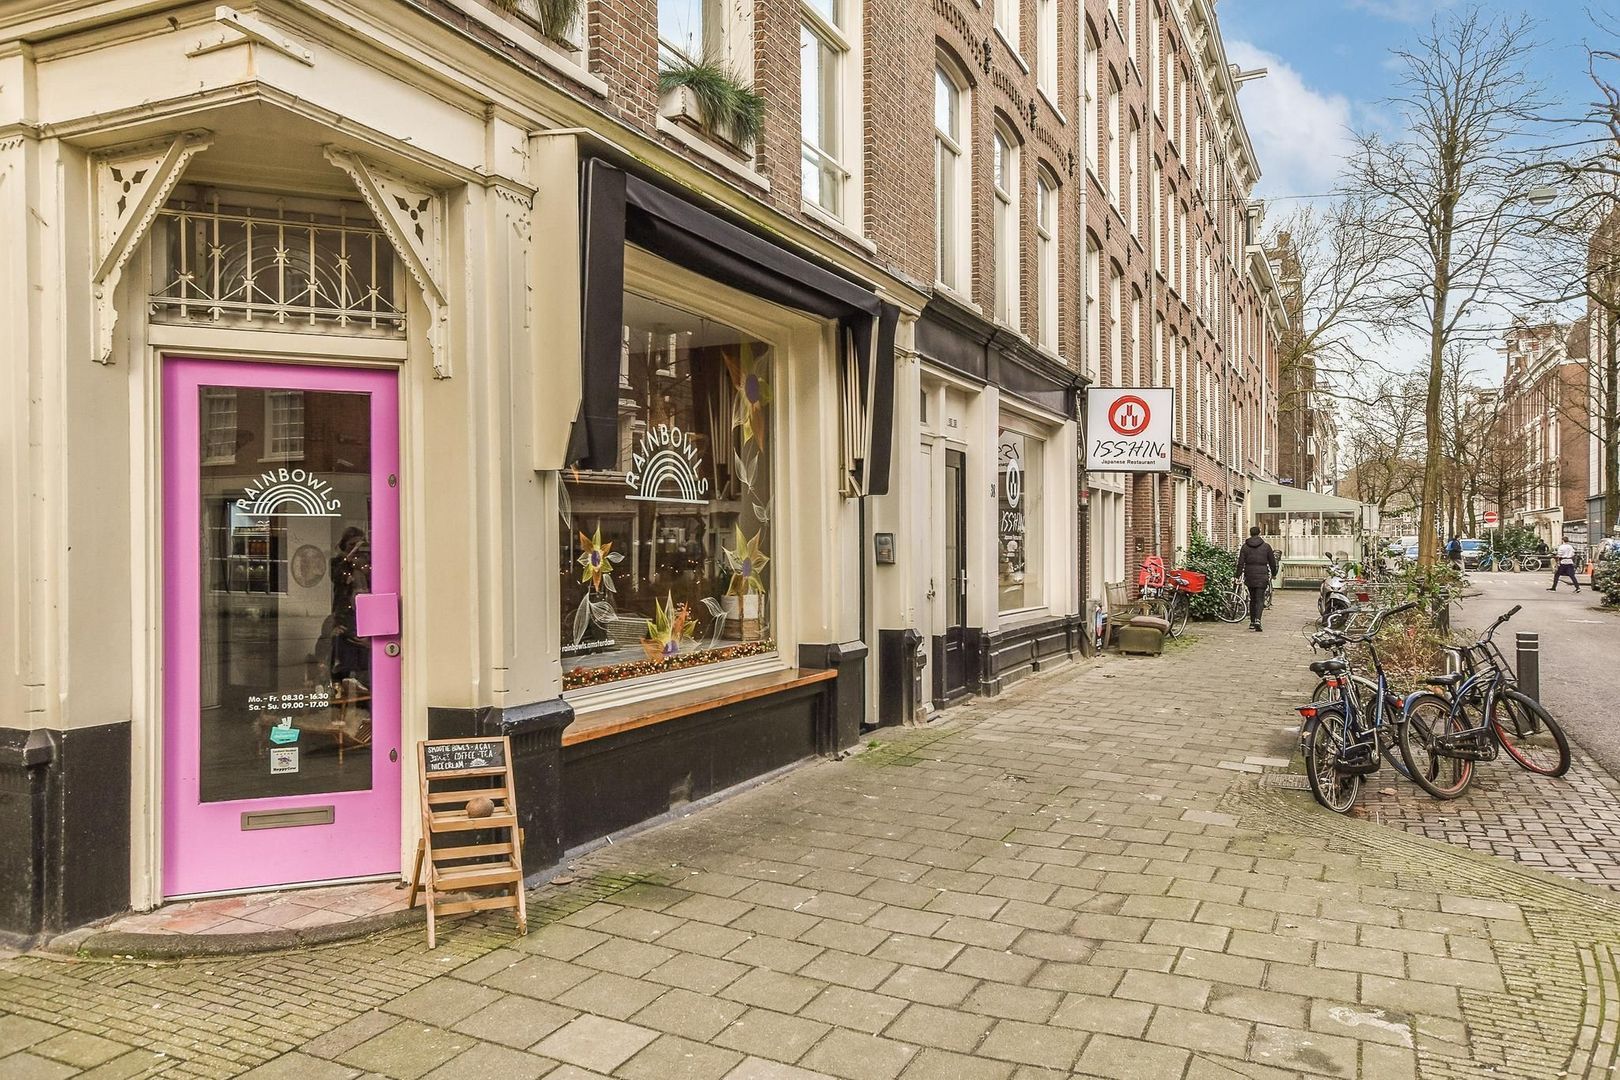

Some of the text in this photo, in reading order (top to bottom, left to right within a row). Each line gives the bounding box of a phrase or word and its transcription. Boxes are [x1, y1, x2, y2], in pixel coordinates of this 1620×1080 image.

[625, 423, 709, 495] RAINBOWLS
[1092, 439, 1165, 458] ISSHIN
[236, 468, 341, 511] RAINBOWLS
[454, 751, 475, 760] COFFEE
